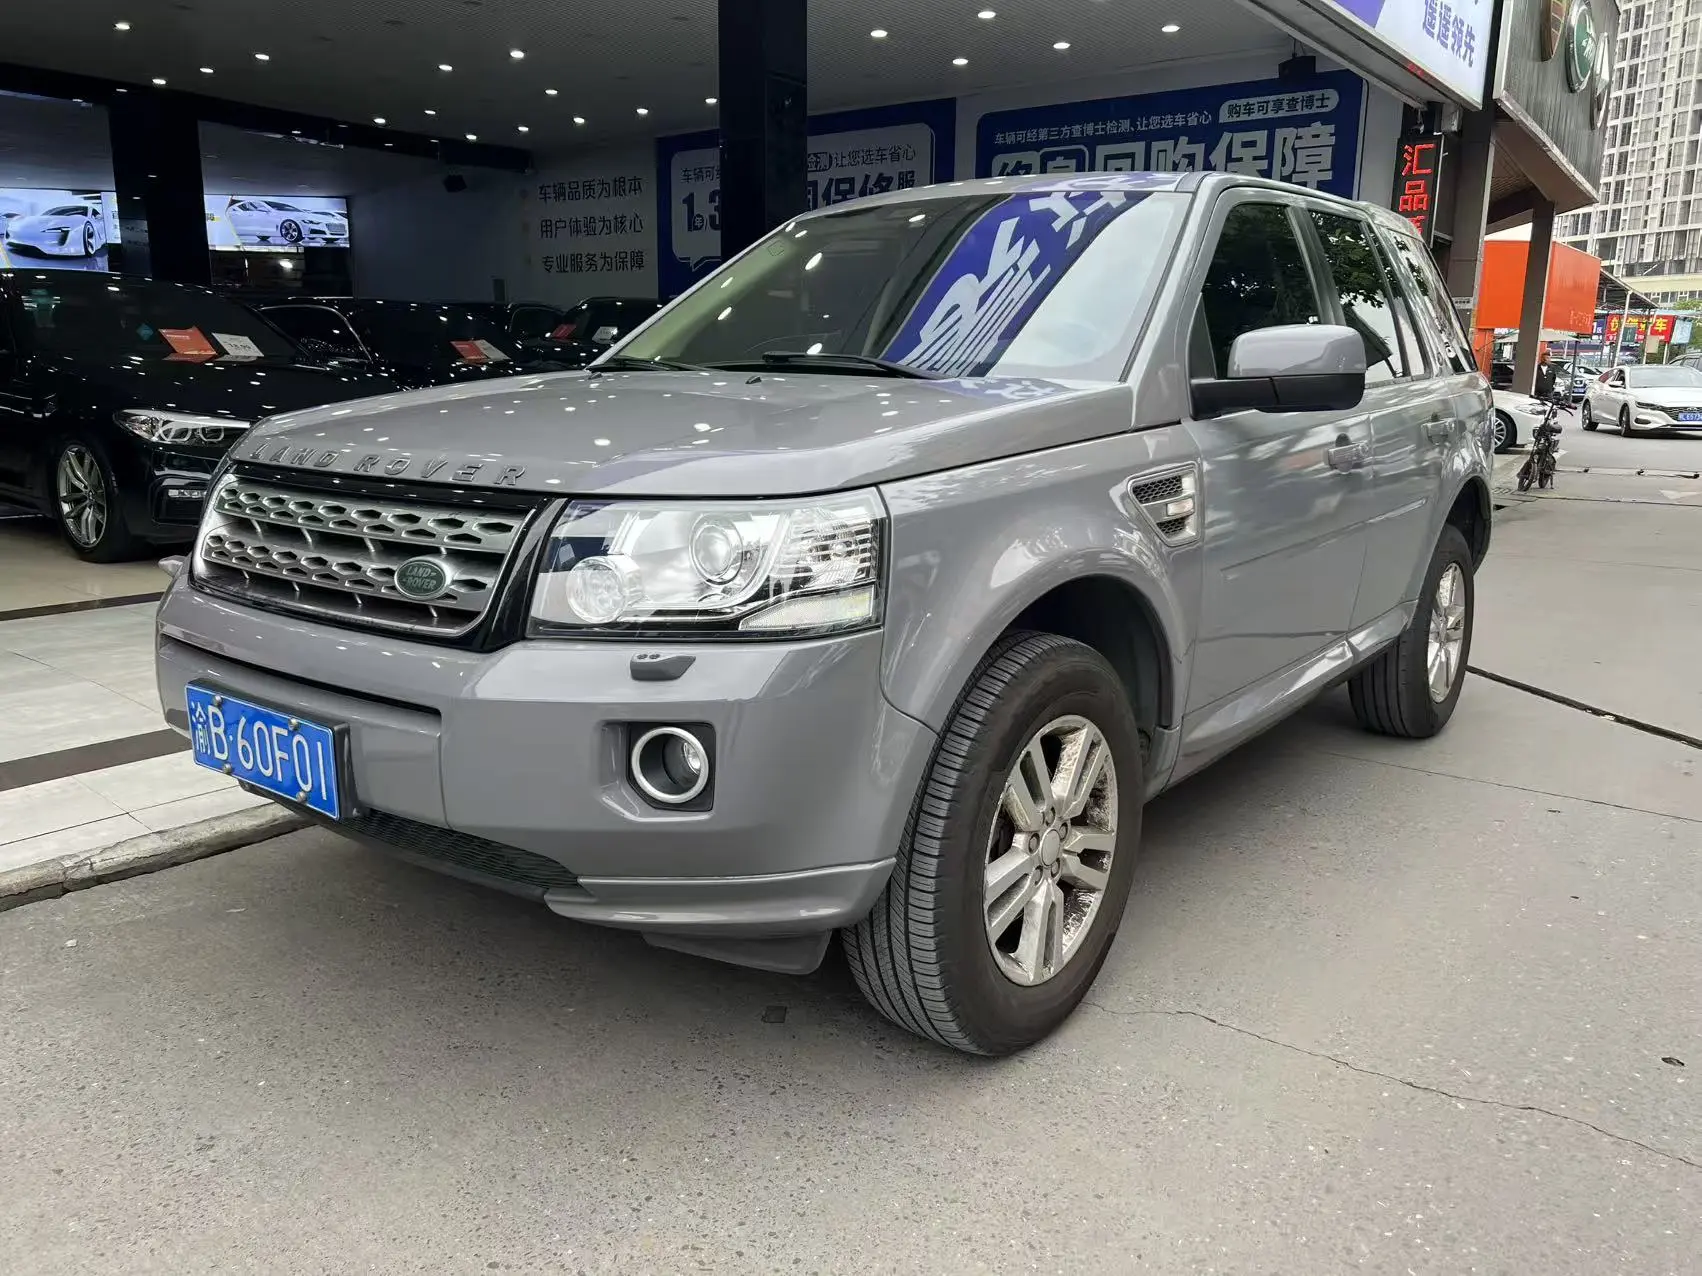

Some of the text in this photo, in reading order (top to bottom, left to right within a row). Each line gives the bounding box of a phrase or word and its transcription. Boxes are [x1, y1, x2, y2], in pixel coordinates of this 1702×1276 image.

[1422, 0, 1476, 68] 遥遥领先
[1227, 93, 1331, 119] 购车可享查博士
[538, 176, 643, 204] 车辆品质为根本
[540, 212, 644, 239] 用户体验为核心
[541, 250, 645, 274] 专业服务为保障
[250, 443, 526, 486] LAND ROVER
